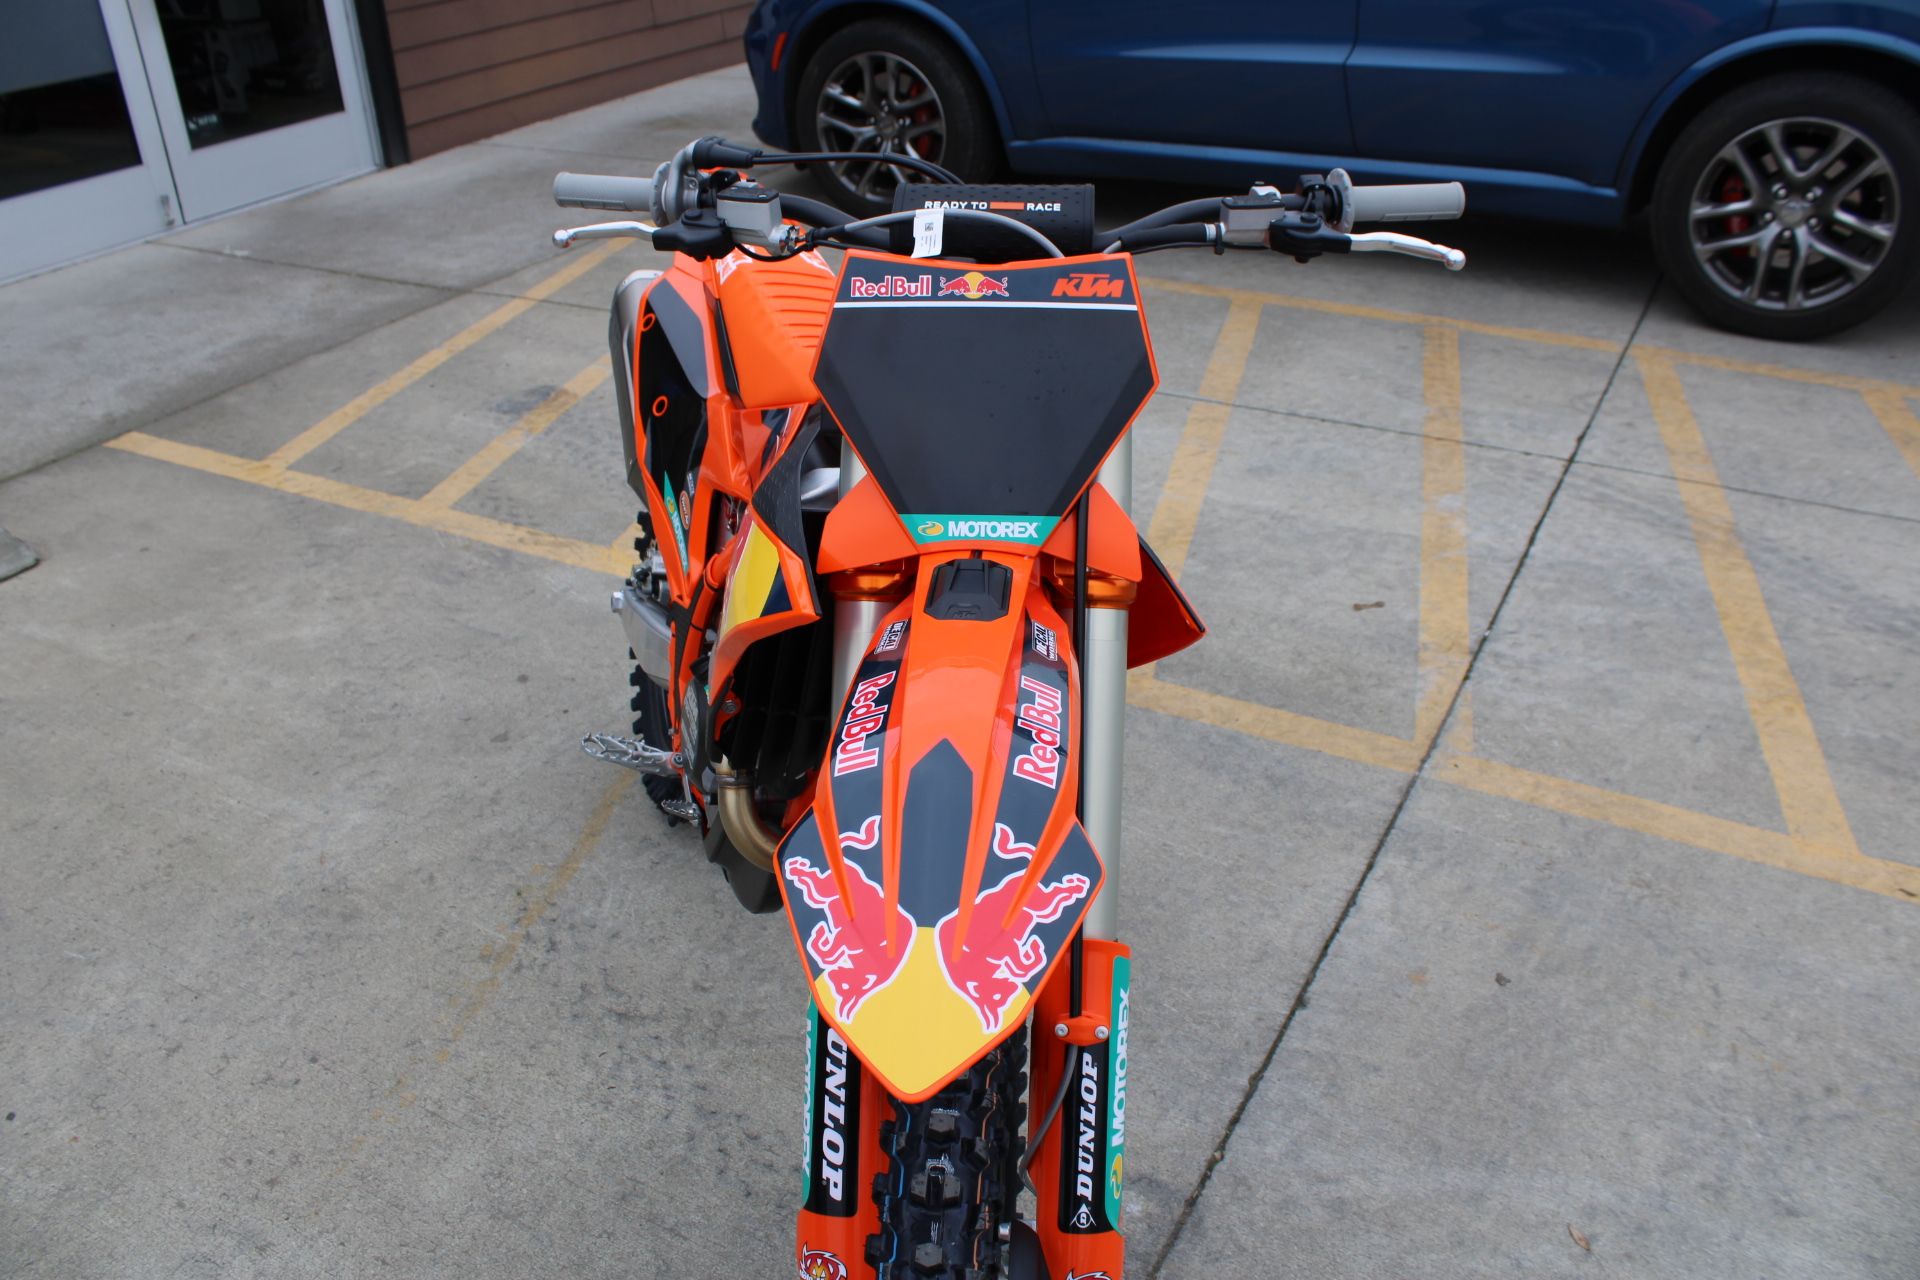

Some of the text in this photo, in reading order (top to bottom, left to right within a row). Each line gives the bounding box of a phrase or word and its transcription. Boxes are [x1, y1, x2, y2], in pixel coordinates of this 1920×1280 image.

[924, 201, 1061, 211] READY TO RACE
[1051, 273, 1124, 297] KTM
[948, 521, 1039, 538] MOTOREX
[1034, 622, 1048, 656] DECAL
[1112, 988, 1130, 1147] MOTOREX
[822, 1028, 848, 1201] UNLOP
[1076, 1052, 1098, 1202] DUNLOP
